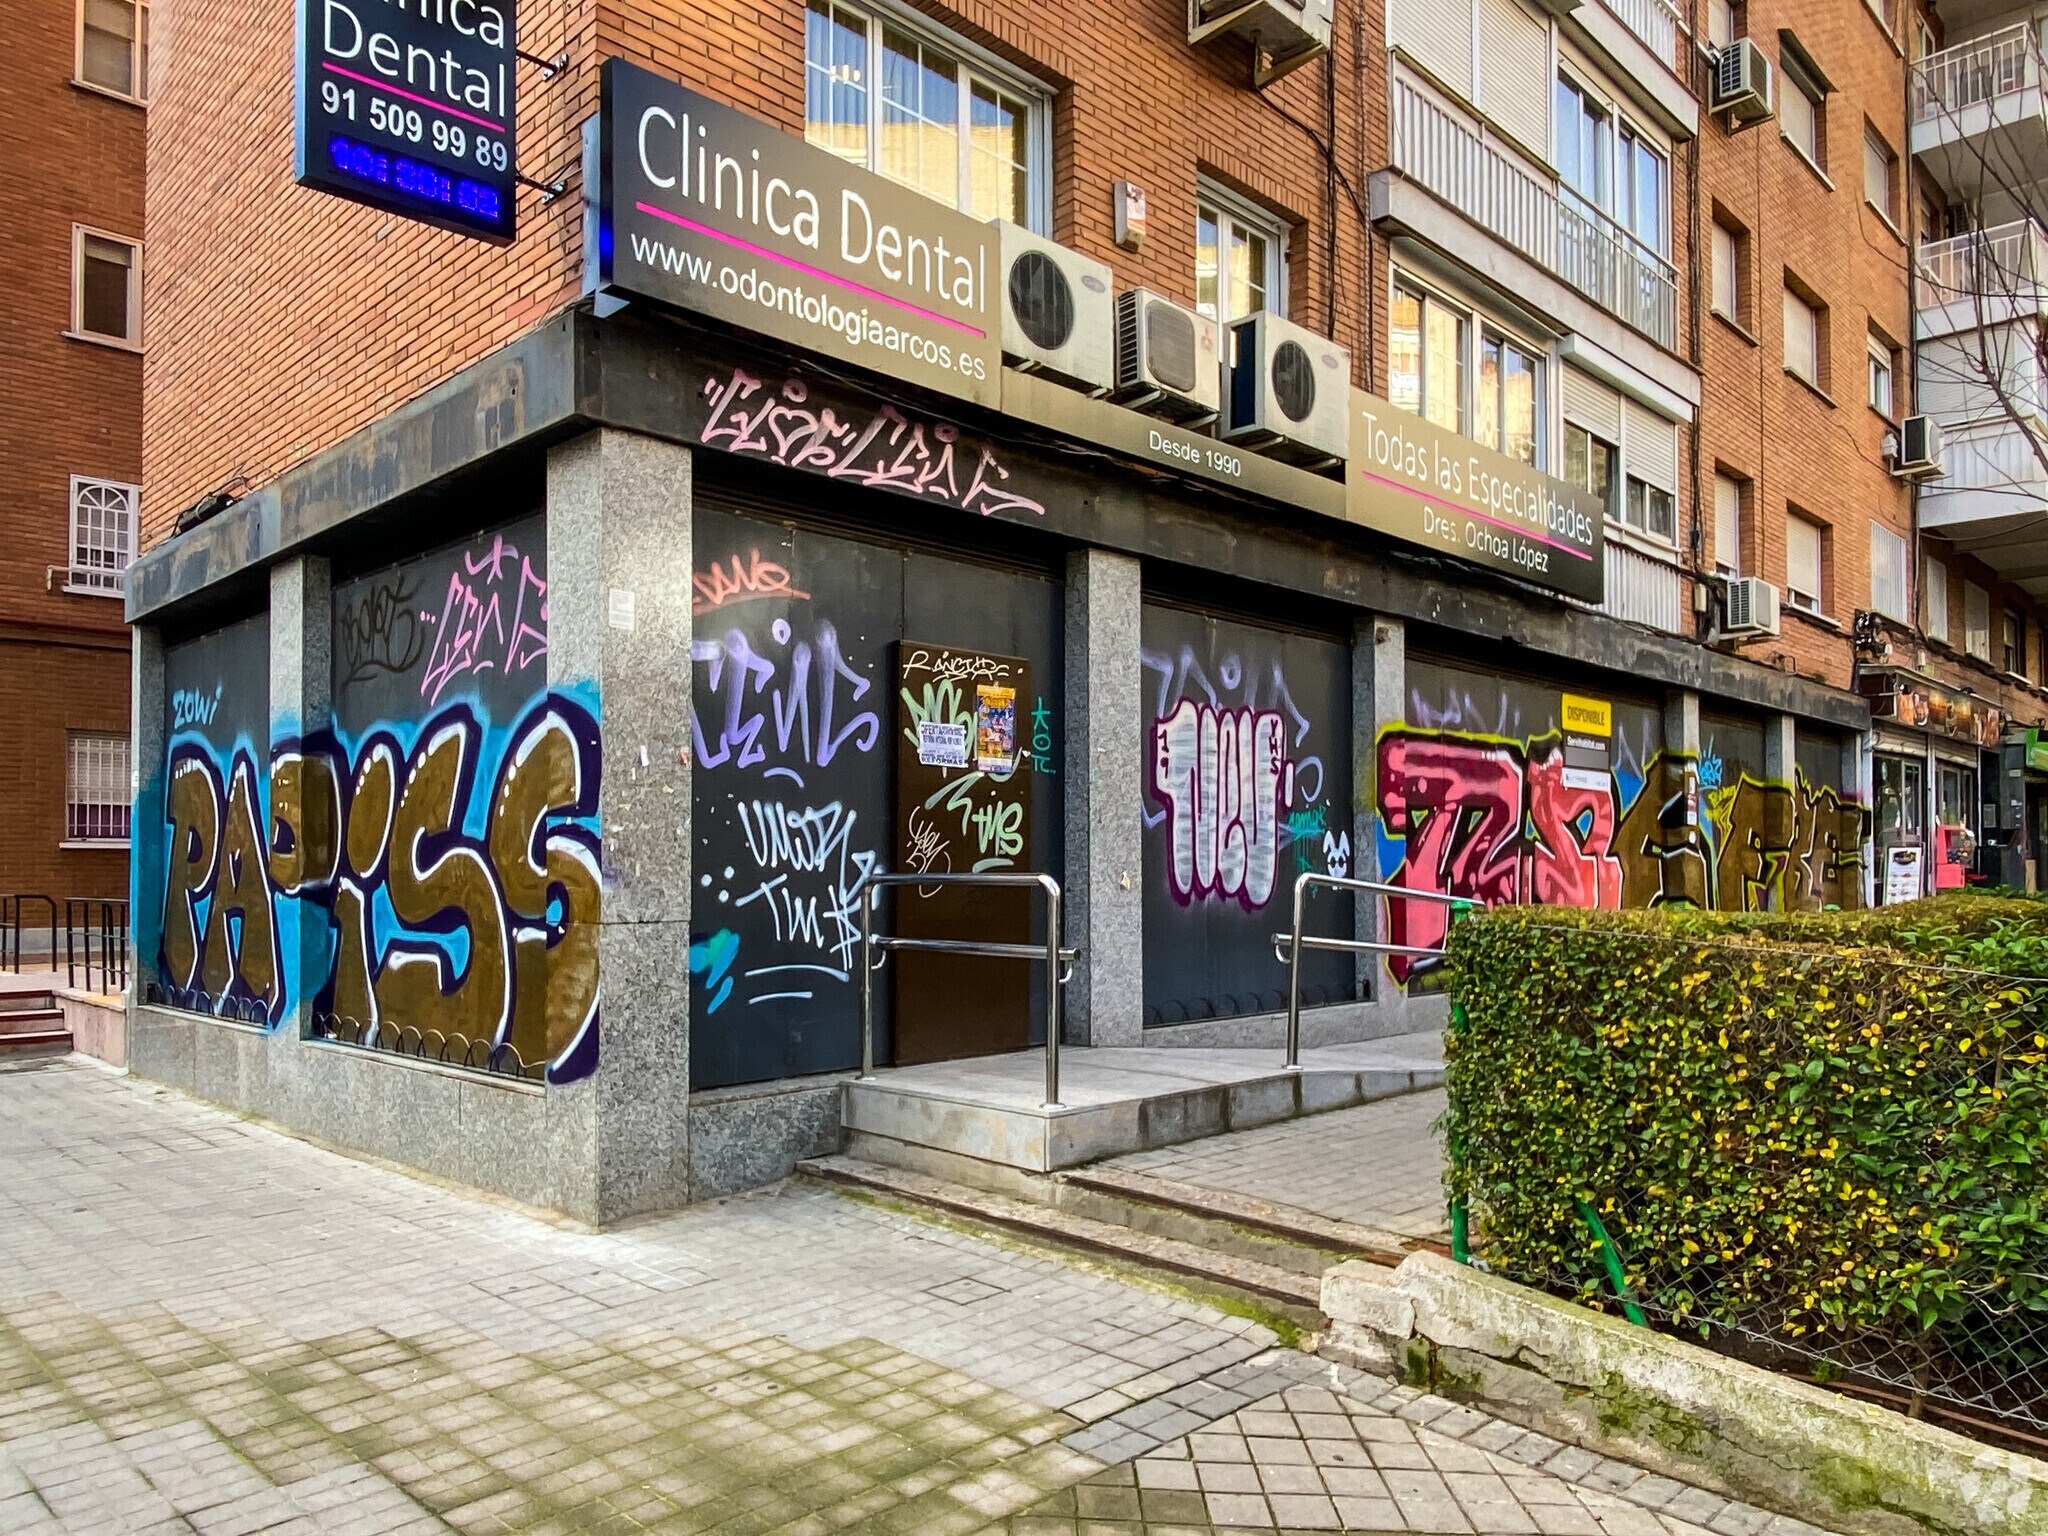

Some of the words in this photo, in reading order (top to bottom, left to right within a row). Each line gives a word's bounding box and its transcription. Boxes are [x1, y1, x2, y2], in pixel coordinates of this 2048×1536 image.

[323, 0, 505, 117] Dental
[322, 81, 356, 120] 91
[370, 98, 423, 142] 509
[432, 119, 466, 157] 99
[475, 136, 508, 172] 89
[841, 189, 985, 313] Dental
[631, 233, 986, 381] www.odontologiaarcos.es
[1149, 430, 1201, 463] Desde
[1206, 449, 1241, 477] 1990
[1362, 411, 1427, 482] Todas
[1434, 439, 1462, 495] las
[1469, 457, 1592, 546] Especialidades
[1423, 506, 1460, 543] Dres.
[1465, 520, 1509, 560] Ochoa
[1512, 538, 1549, 573] López
[1567, 705, 1605, 726] DISPONIBLE
